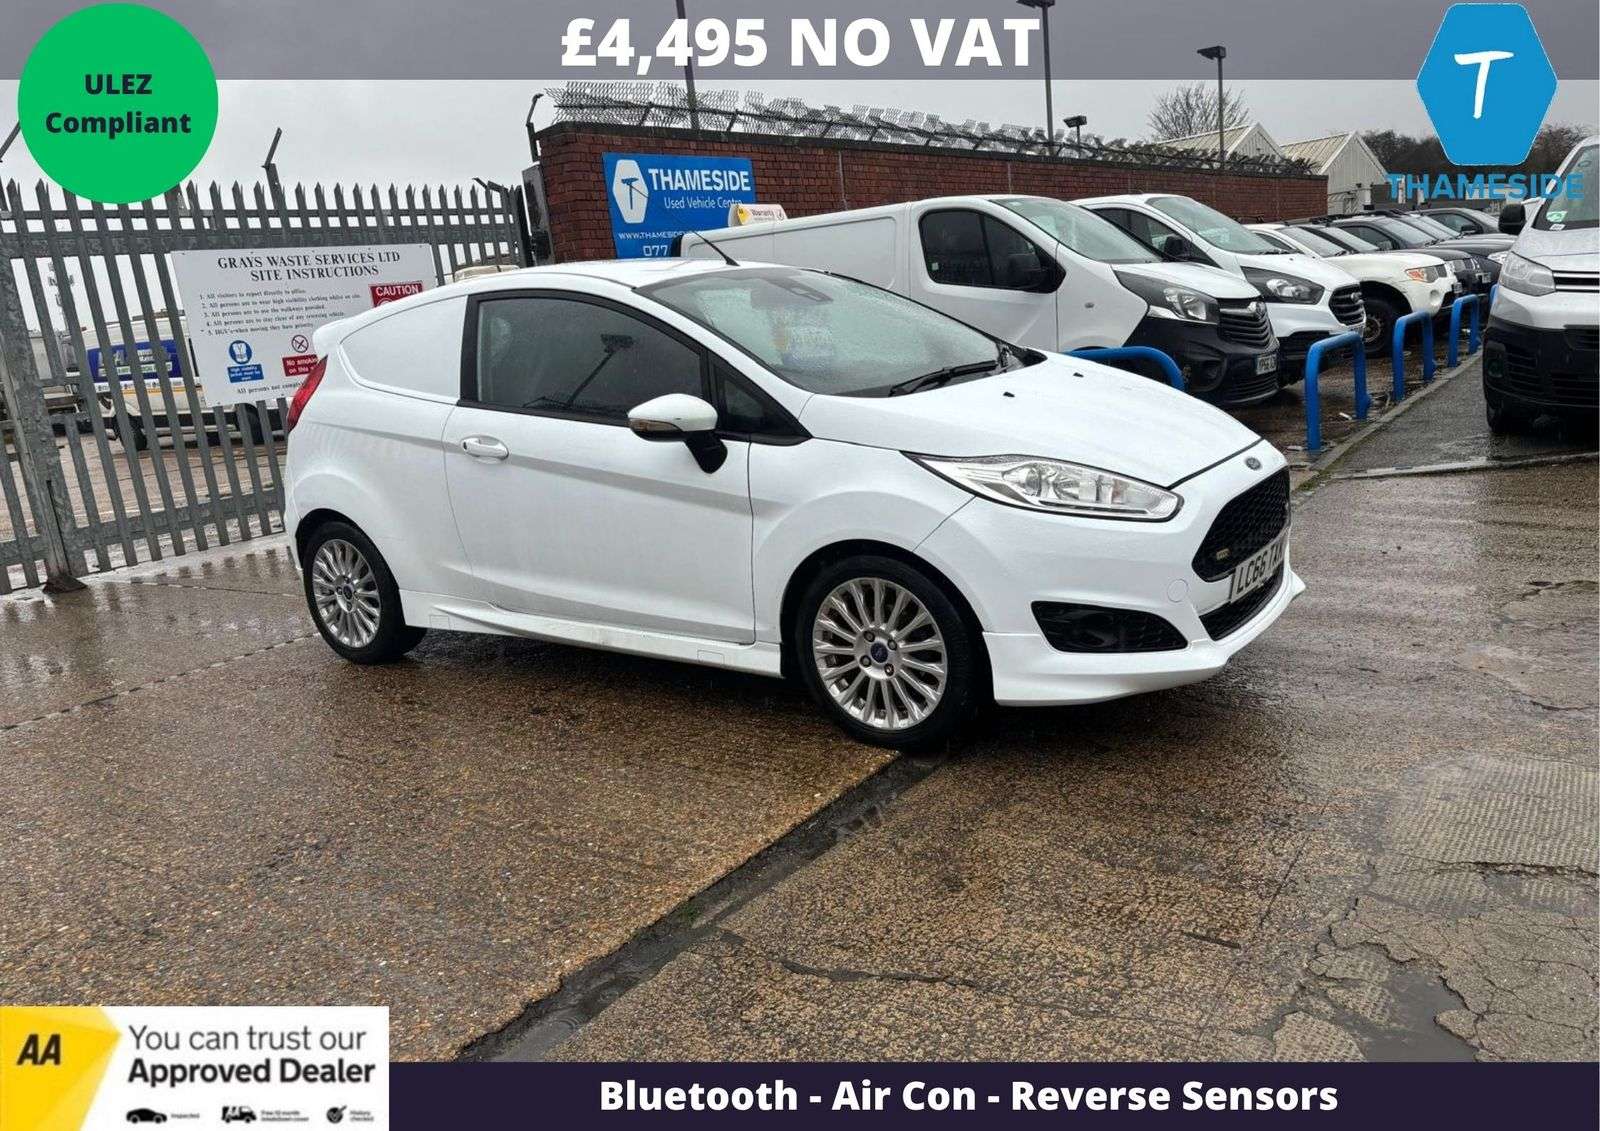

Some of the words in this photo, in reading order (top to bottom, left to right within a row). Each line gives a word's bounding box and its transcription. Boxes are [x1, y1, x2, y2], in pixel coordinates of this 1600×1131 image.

[648, 168, 752, 192] THAMESIDE
[664, 196, 685, 209] Used
[687, 196, 716, 209] Vehicle
[218, 256, 262, 269] GRAYS
[266, 254, 311, 268] WASTE
[315, 252, 375, 266] SERVICES
[379, 251, 401, 262] LTD
[250, 268, 282, 282] SITE
[287, 265, 379, 280] INSTRUCTIONS
[375, 284, 419, 297] CAUTION
